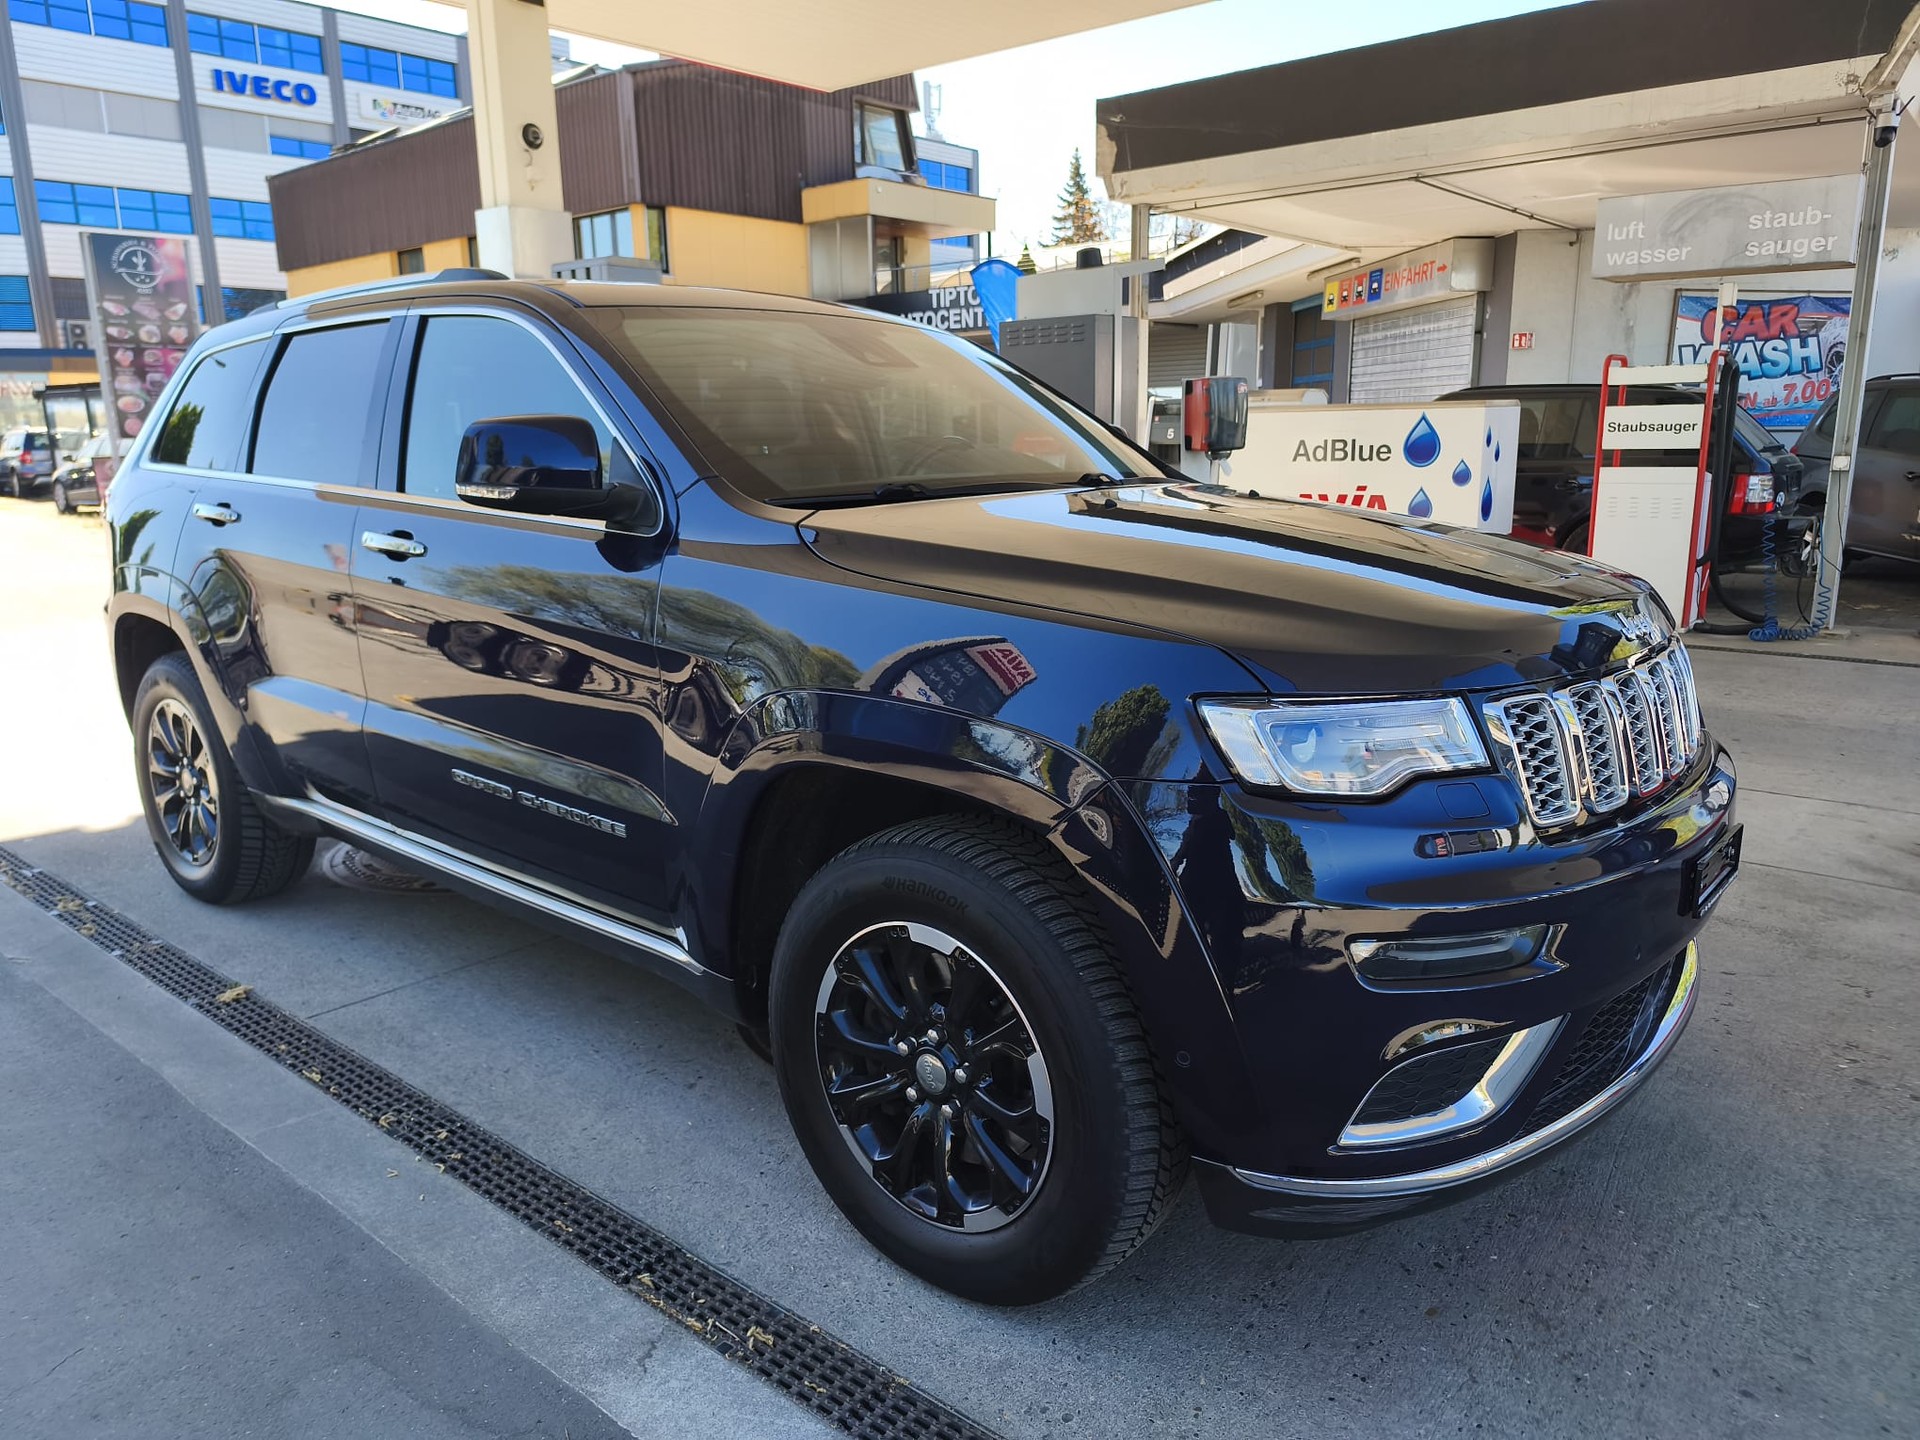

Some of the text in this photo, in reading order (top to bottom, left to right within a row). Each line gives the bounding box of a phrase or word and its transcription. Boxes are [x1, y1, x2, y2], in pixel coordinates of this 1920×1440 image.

[213, 69, 318, 107] IVECO
[1748, 205, 1832, 231] staub-
[1607, 221, 1646, 242] luft
[1606, 245, 1692, 266] wasser
[1744, 234, 1838, 258] sauger
[1383, 260, 1437, 292] EINFAHRT
[928, 286, 981, 308] TIPTO
[1701, 303, 1800, 344] CAR
[1782, 378, 1832, 406] 7.00
[1607, 421, 1699, 435] Staubsauger
[1291, 438, 1392, 462] AdBlue
[516, 790, 628, 839] CHEROKEE
